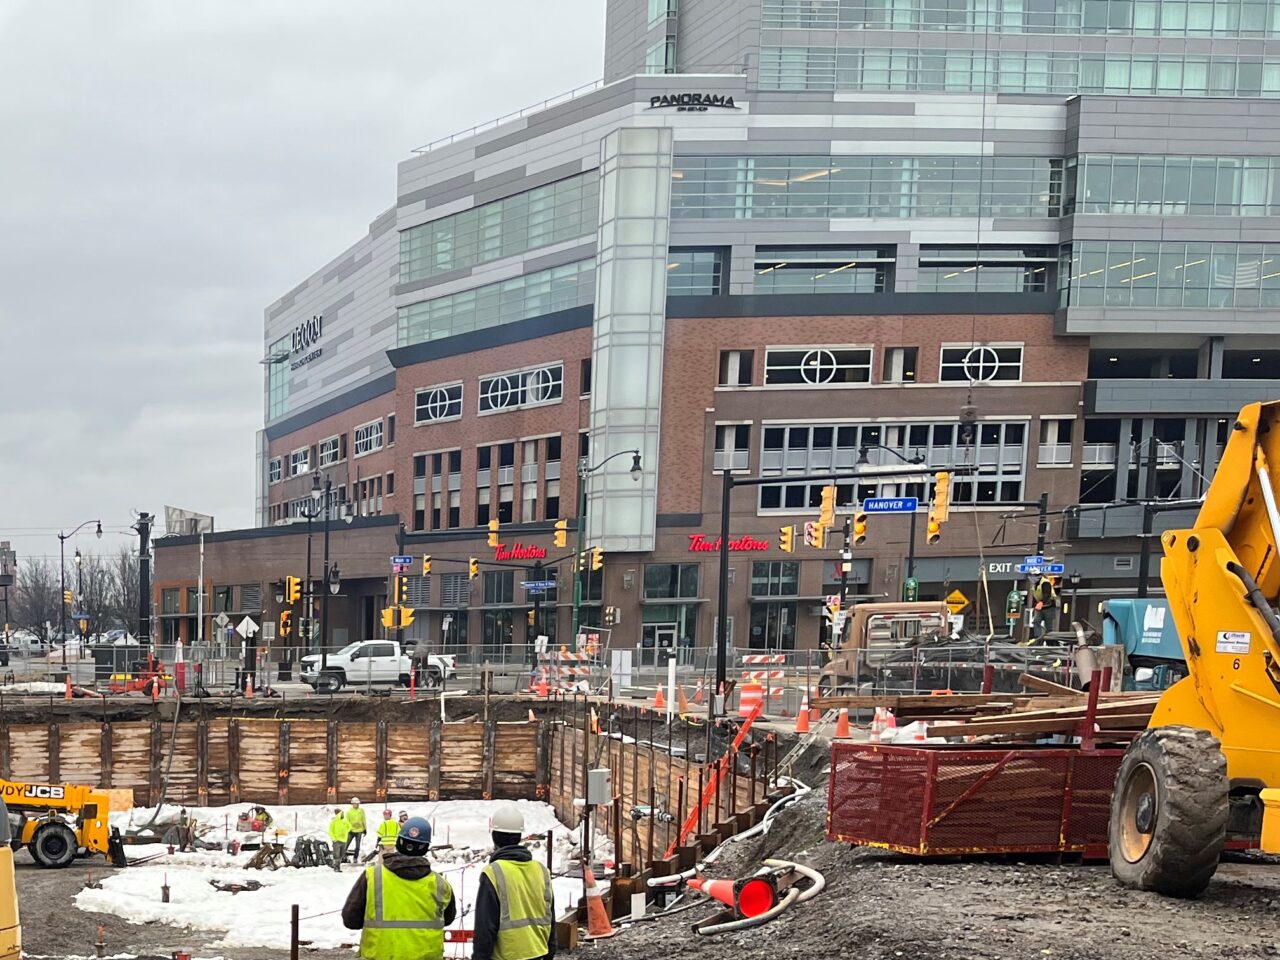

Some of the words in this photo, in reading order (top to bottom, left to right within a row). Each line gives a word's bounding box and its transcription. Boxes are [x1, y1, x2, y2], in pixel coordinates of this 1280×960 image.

[650, 93, 735, 108] PANORAMA
[868, 501, 903, 509] HANOVER
[688, 534, 713, 552] Tim
[495, 543, 511, 560] Tim
[512, 543, 547, 559] Hortons
[989, 563, 1012, 573] EXIT
[1233, 658, 1240, 670] 6
[25, 785, 64, 799] JCB
